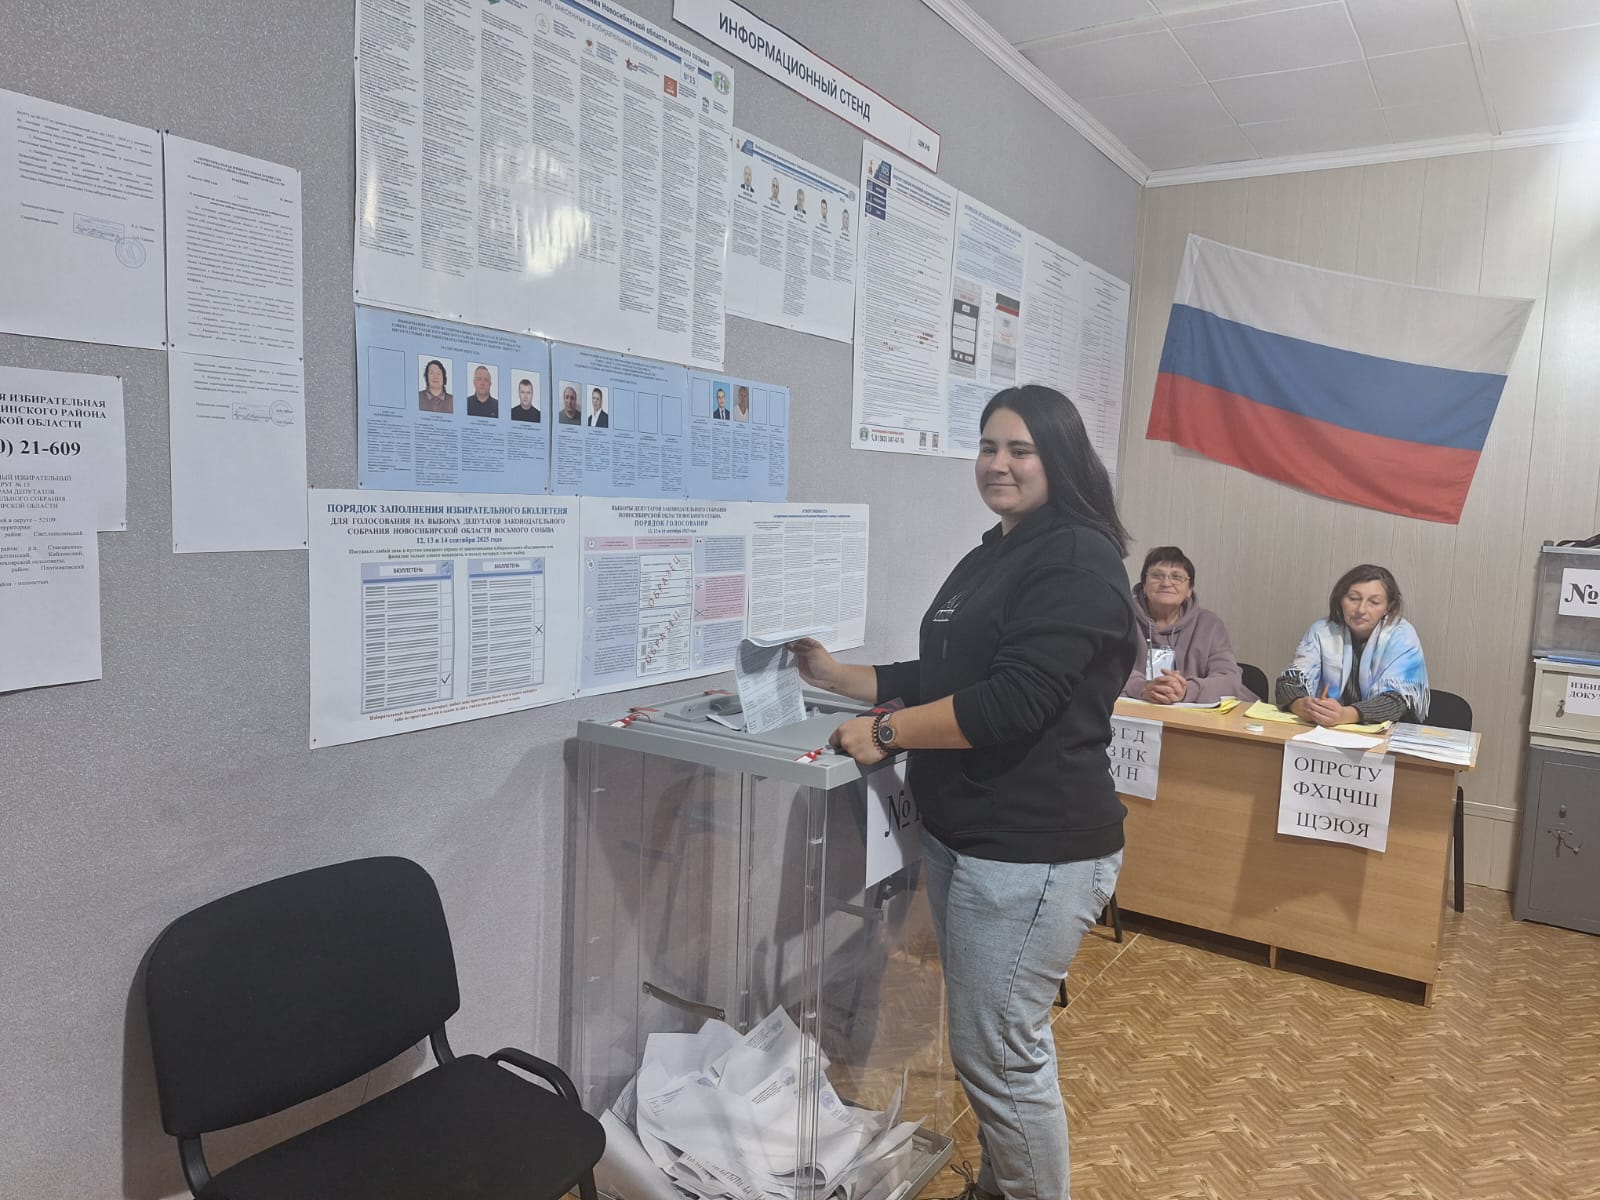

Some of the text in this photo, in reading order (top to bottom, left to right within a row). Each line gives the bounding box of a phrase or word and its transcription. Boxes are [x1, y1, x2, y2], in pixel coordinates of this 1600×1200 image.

[602, 1, 646, 33] Новосибирской
[646, 27, 667, 43] области
[719, 12, 871, 123] ИНФОРМАЦИОННЫЙ СТЕНД
[9, 393, 106, 408] ИЗБИРАТЕЛЬНАЯ
[61, 408, 107, 419] РАЙОНА
[26, 417, 82, 429] ОБЛАСТИ
[20, 439, 81, 456] 21-609
[327, 504, 568, 515] ПОРЯДОК ЗАПОЛНЕНИЯ ИЗБИРАТЕЛЬНОГО БЮЛЛЕТЕНЯ
[331, 518, 348, 526] ДЛЯ
[634, 519, 665, 527] ПОРЯДОК
[347, 527, 390, 535] СОБРАНИЯ
[393, 526, 458, 535] НОВОСИБИРСКОЙ
[393, 566, 424, 574] БЮЛЛЕТЕНЬ
[1293, 756, 1383, 784] ОПРСТУ
[1293, 781, 1379, 809] ФХЦЧШ
[1295, 811, 1370, 838] ЩЭЮЯ
